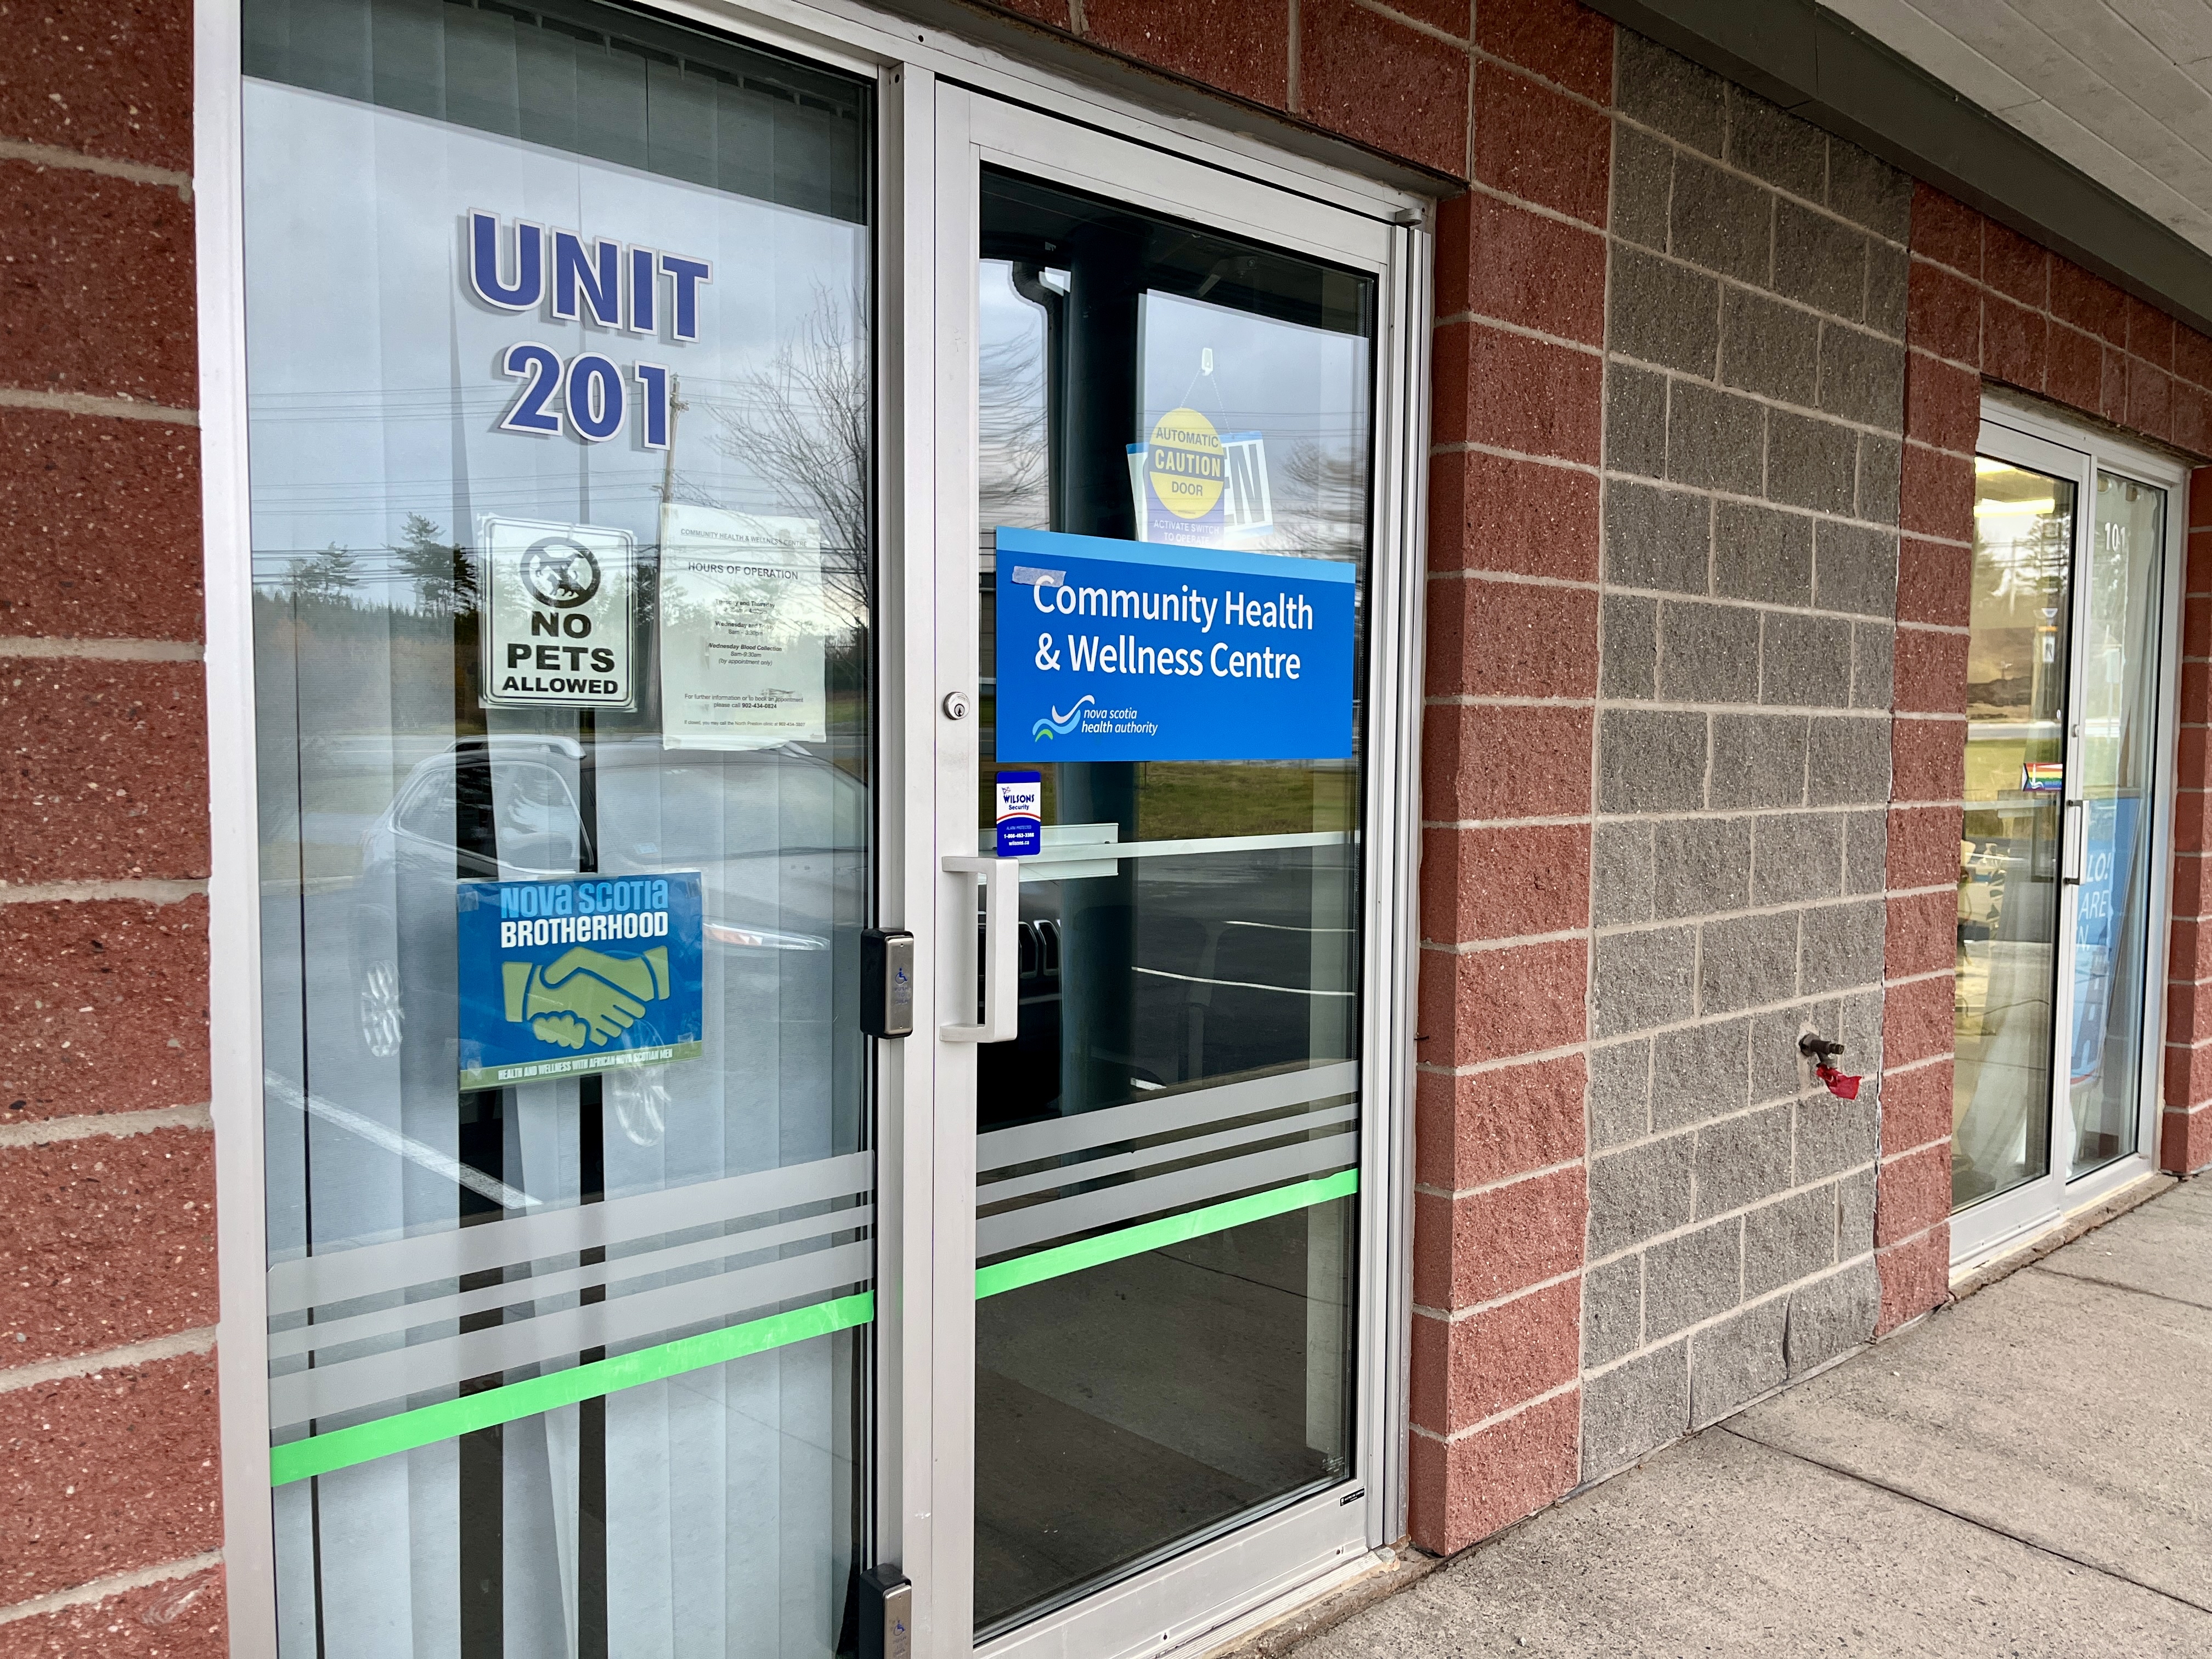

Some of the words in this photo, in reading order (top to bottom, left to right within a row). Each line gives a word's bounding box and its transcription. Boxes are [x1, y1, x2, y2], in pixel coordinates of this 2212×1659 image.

[469, 207, 713, 342] UNIT
[500, 341, 670, 449] 201
[1156, 427, 1218, 448] AUTOMATIC
[1155, 449, 1221, 478] CAUTION
[1172, 481, 1203, 496] DOOR
[681, 528, 718, 538] COMMUNITY
[719, 533, 743, 541] HEALTH
[751, 537, 782, 545] WELLNESS
[1154, 520, 1189, 532] ACTIVATE
[1191, 523, 1220, 534] SWITCH
[1164, 532, 1173, 541] TO
[1176, 533, 1210, 545] OPERATE
[2104, 522, 2126, 552] 101
[689, 562, 724, 573] HOURS
[726, 566, 741, 574] OF
[743, 567, 798, 580] OPERATION
[1033, 574, 1218, 633] Community
[1225, 590, 1313, 630] Health
[532, 611, 591, 639] NO
[507, 644, 615, 673] PETS
[1035, 632, 1060, 672] &
[1068, 634, 1204, 677] Wellness
[1210, 642, 1301, 680] Centre
[502, 676, 618, 695] ALLOWED
[1084, 709, 1108, 719] nova
[1109, 707, 1137, 719] scotia
[1081, 720, 1113, 733] health
[1115, 721, 1158, 736] authority
[1003, 794, 1034, 804] WILSONS
[2078, 889, 2109, 921] ARE
[498, 1068, 522, 1080] HEALTH
[524, 1065, 537, 1077] AND
[538, 1061, 571, 1075] WELLNESS
[572, 1058, 588, 1070] WITH
[589, 1056, 615, 1068] AFRICAN
[616, 1053, 632, 1065] NOVA
[633, 1050, 659, 1062] SCOTIAN
[660, 1048, 673, 1059] MEN
